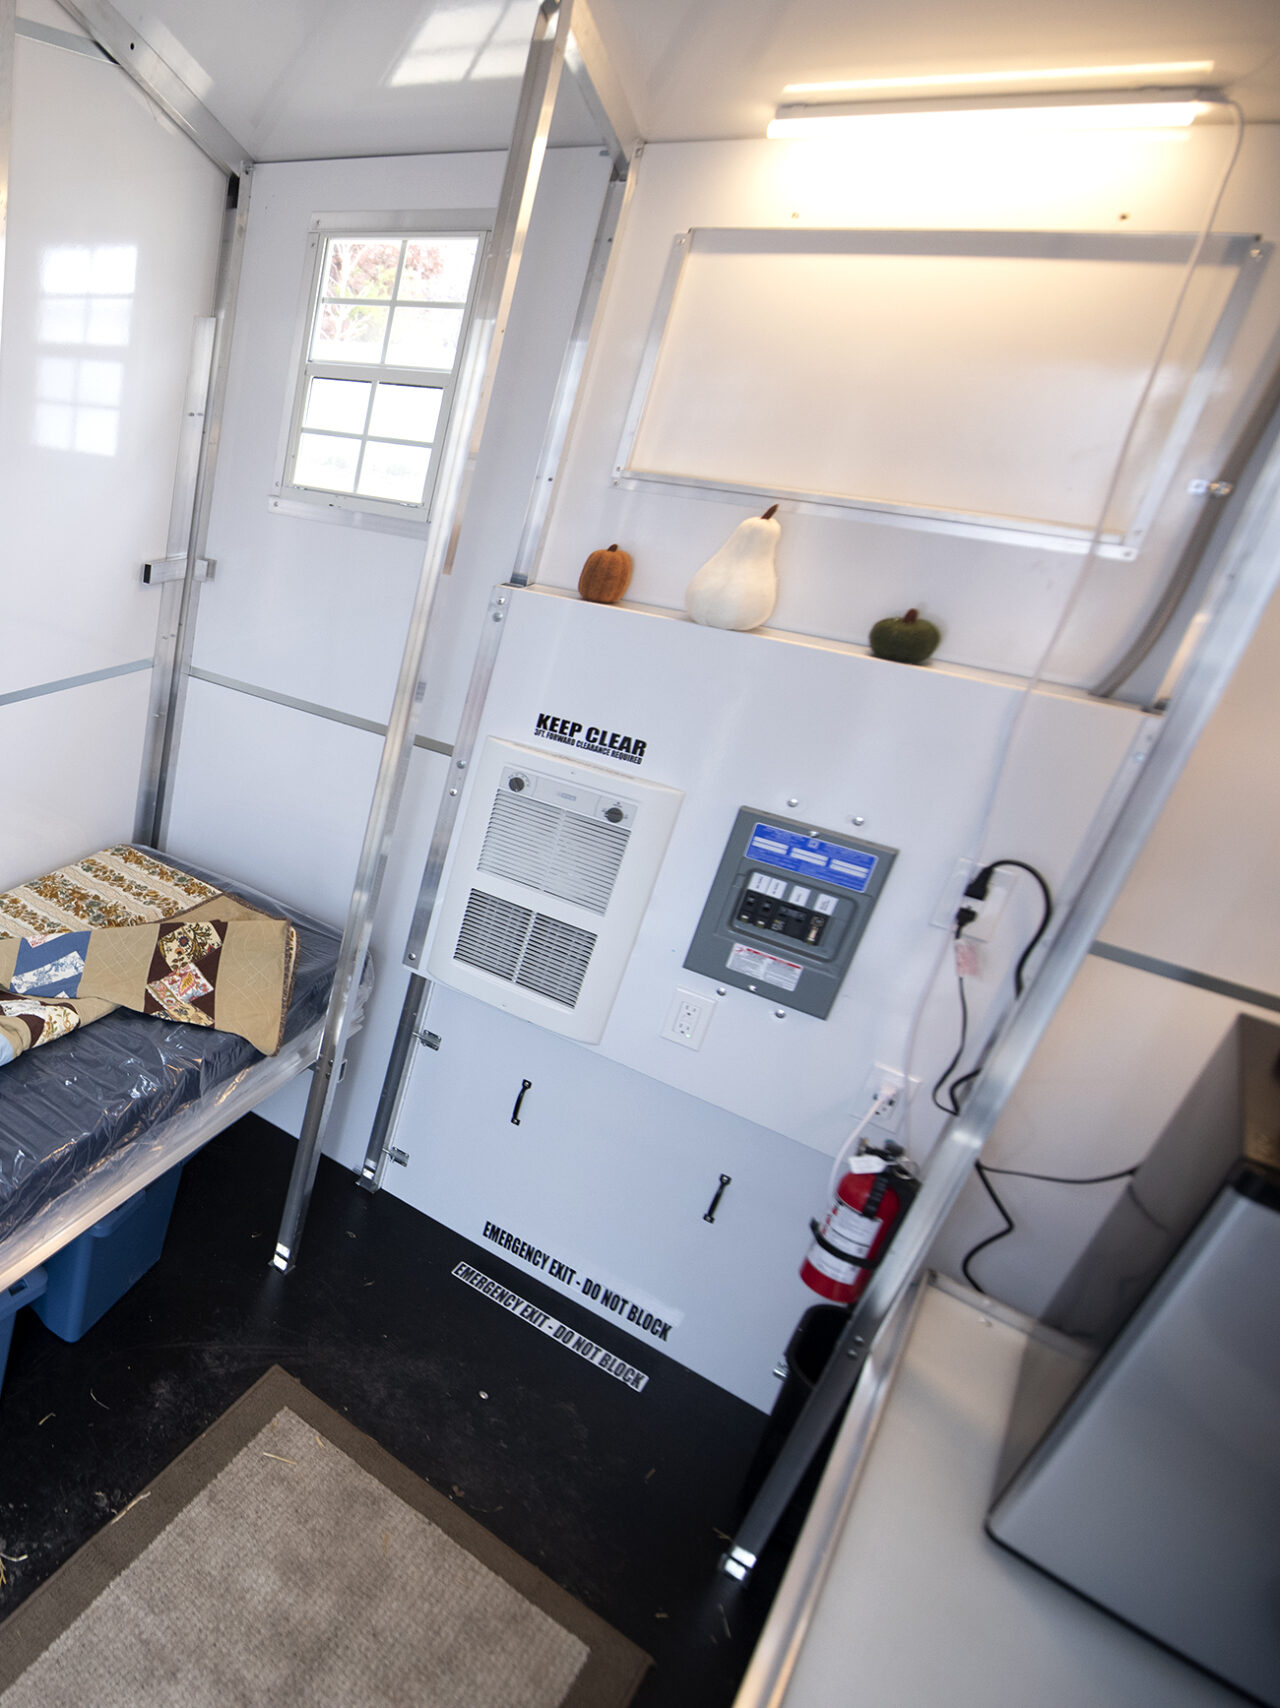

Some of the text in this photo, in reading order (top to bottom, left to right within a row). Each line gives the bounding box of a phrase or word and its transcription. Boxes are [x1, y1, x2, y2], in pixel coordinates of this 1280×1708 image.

[536, 713, 647, 757] KEEP CLEAR
[546, 732, 576, 747] FORWARD
[576, 739, 610, 756] CLEARANCE
[610, 751, 643, 765] REQUIRED
[482, 1221, 550, 1270] EMERGENCY
[548, 1258, 577, 1285] EXIT
[582, 1278, 601, 1300] DO
[600, 1290, 629, 1316] NOT
[627, 1303, 672, 1342] BLOCK
[454, 1263, 524, 1313] EMERGENCY
[520, 1301, 551, 1328] EXIT
[553, 1325, 575, 1345] DO
[572, 1336, 602, 1361] NOT
[598, 1352, 645, 1390] BLOCK
